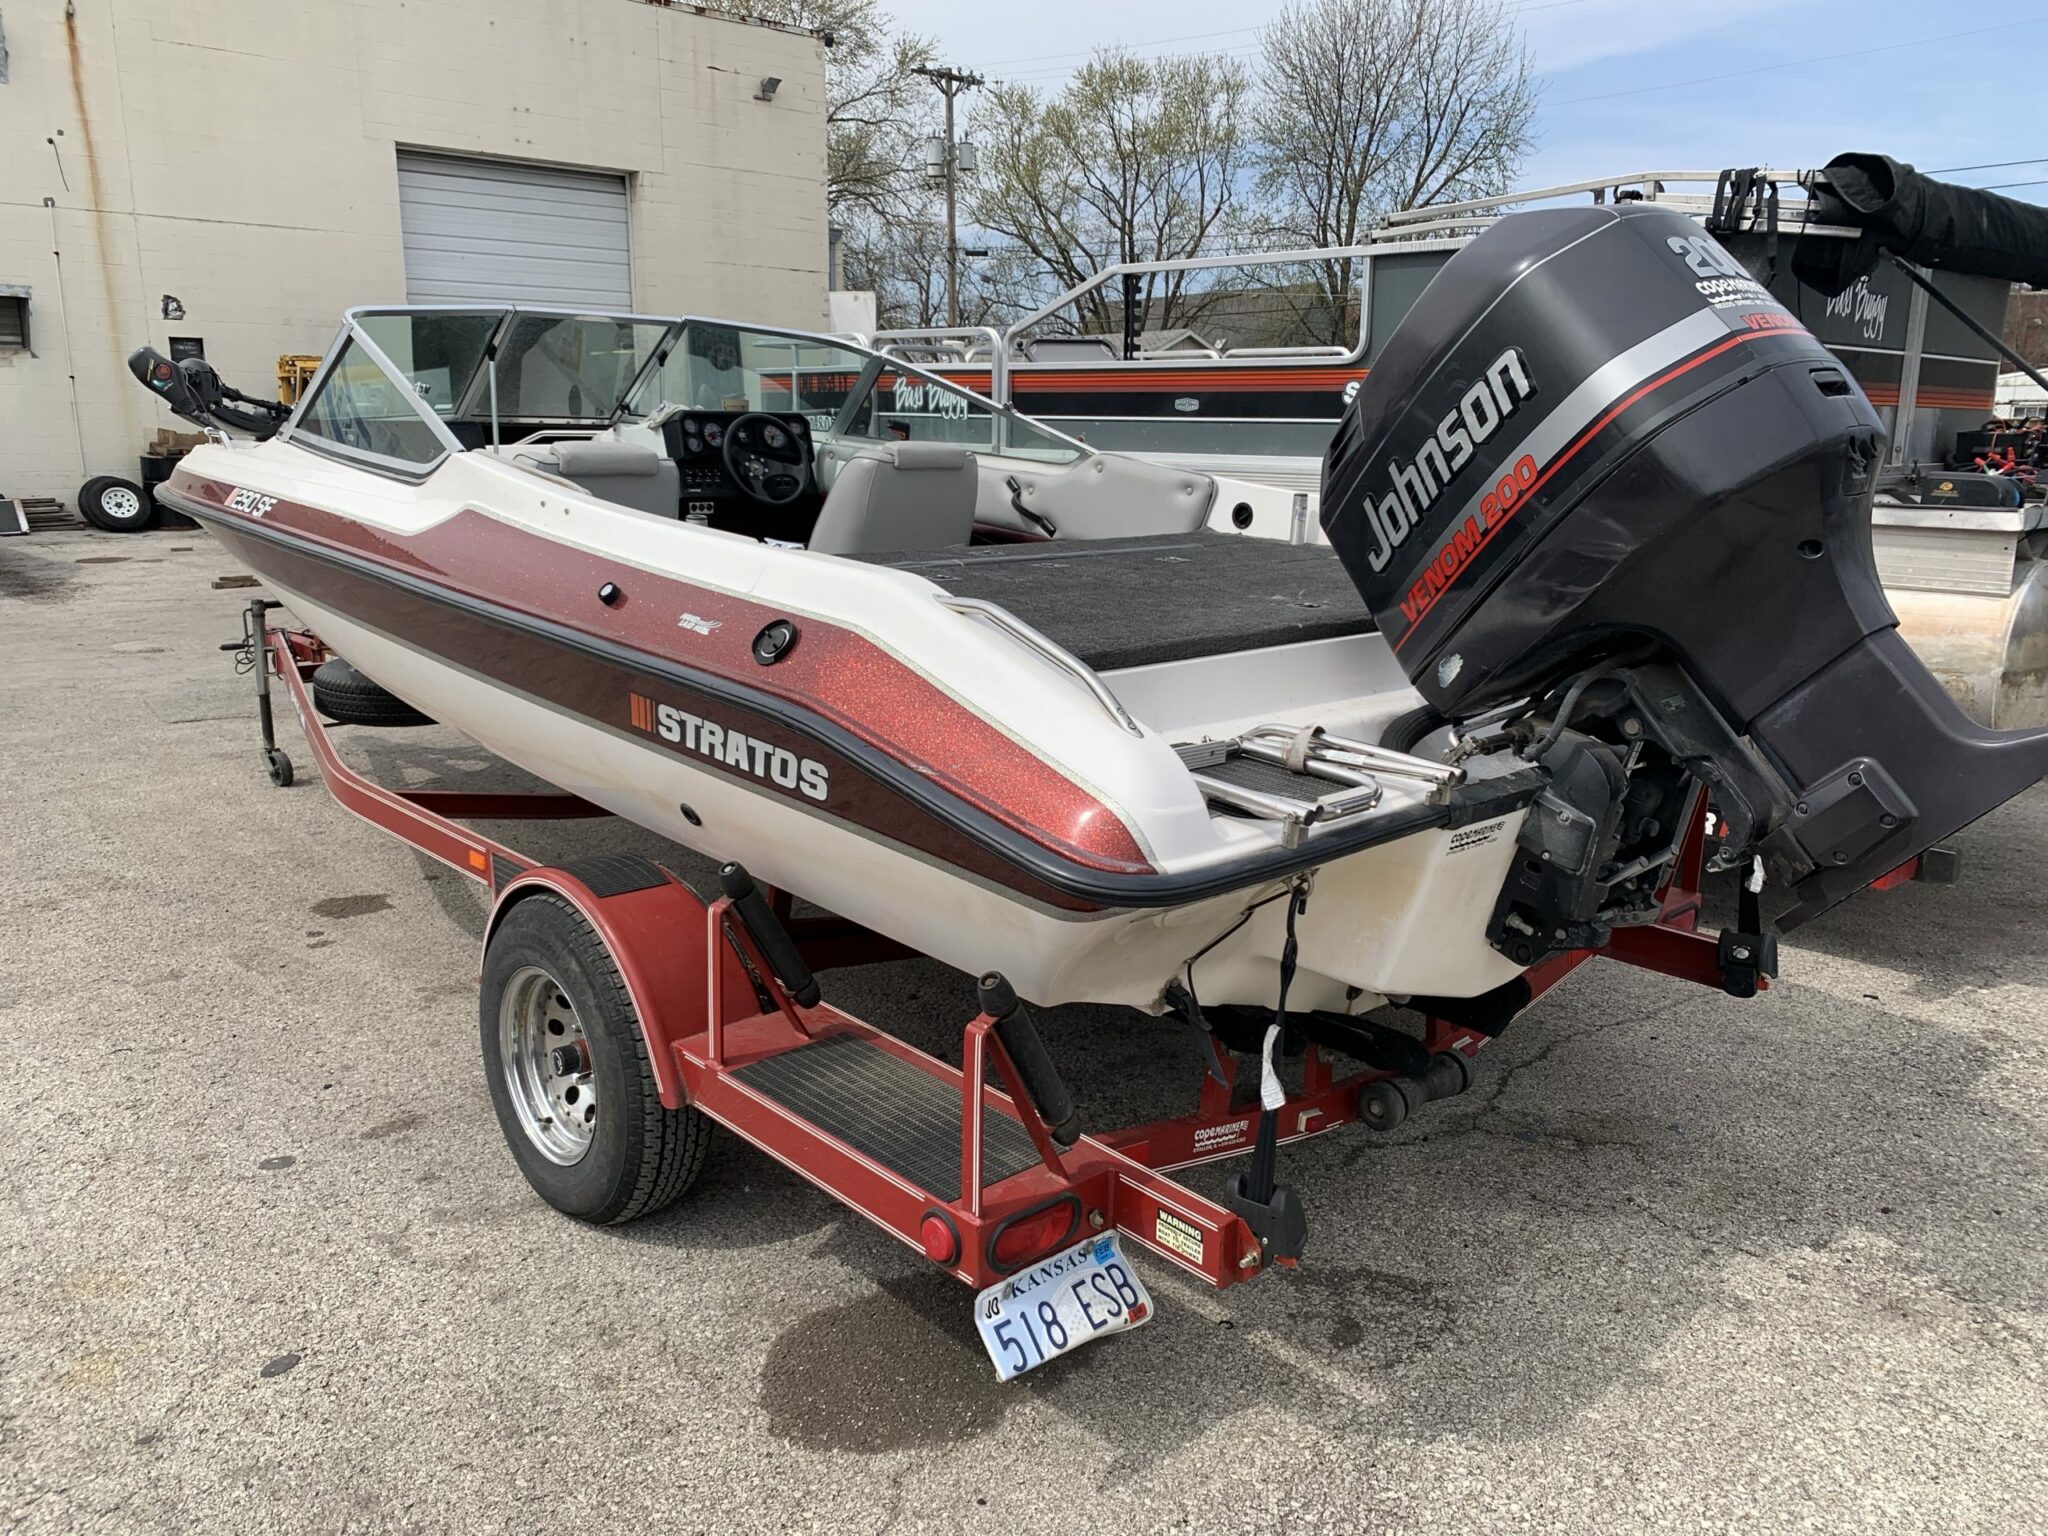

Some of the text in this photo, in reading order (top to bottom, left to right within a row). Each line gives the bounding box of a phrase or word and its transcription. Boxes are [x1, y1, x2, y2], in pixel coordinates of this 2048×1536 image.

[893, 376, 923, 412] Bass
[1363, 346, 1534, 573] Johnson
[252, 496, 279, 518] SF
[1399, 454, 1539, 624] VENOM 200
[657, 703, 829, 801] STRATOS
[1159, 1208, 1202, 1242] WARNING
[1010, 1249, 1089, 1299] KANSAS
[984, 1296, 1001, 1320] JO
[992, 1263, 1139, 1373] 518 ESB
